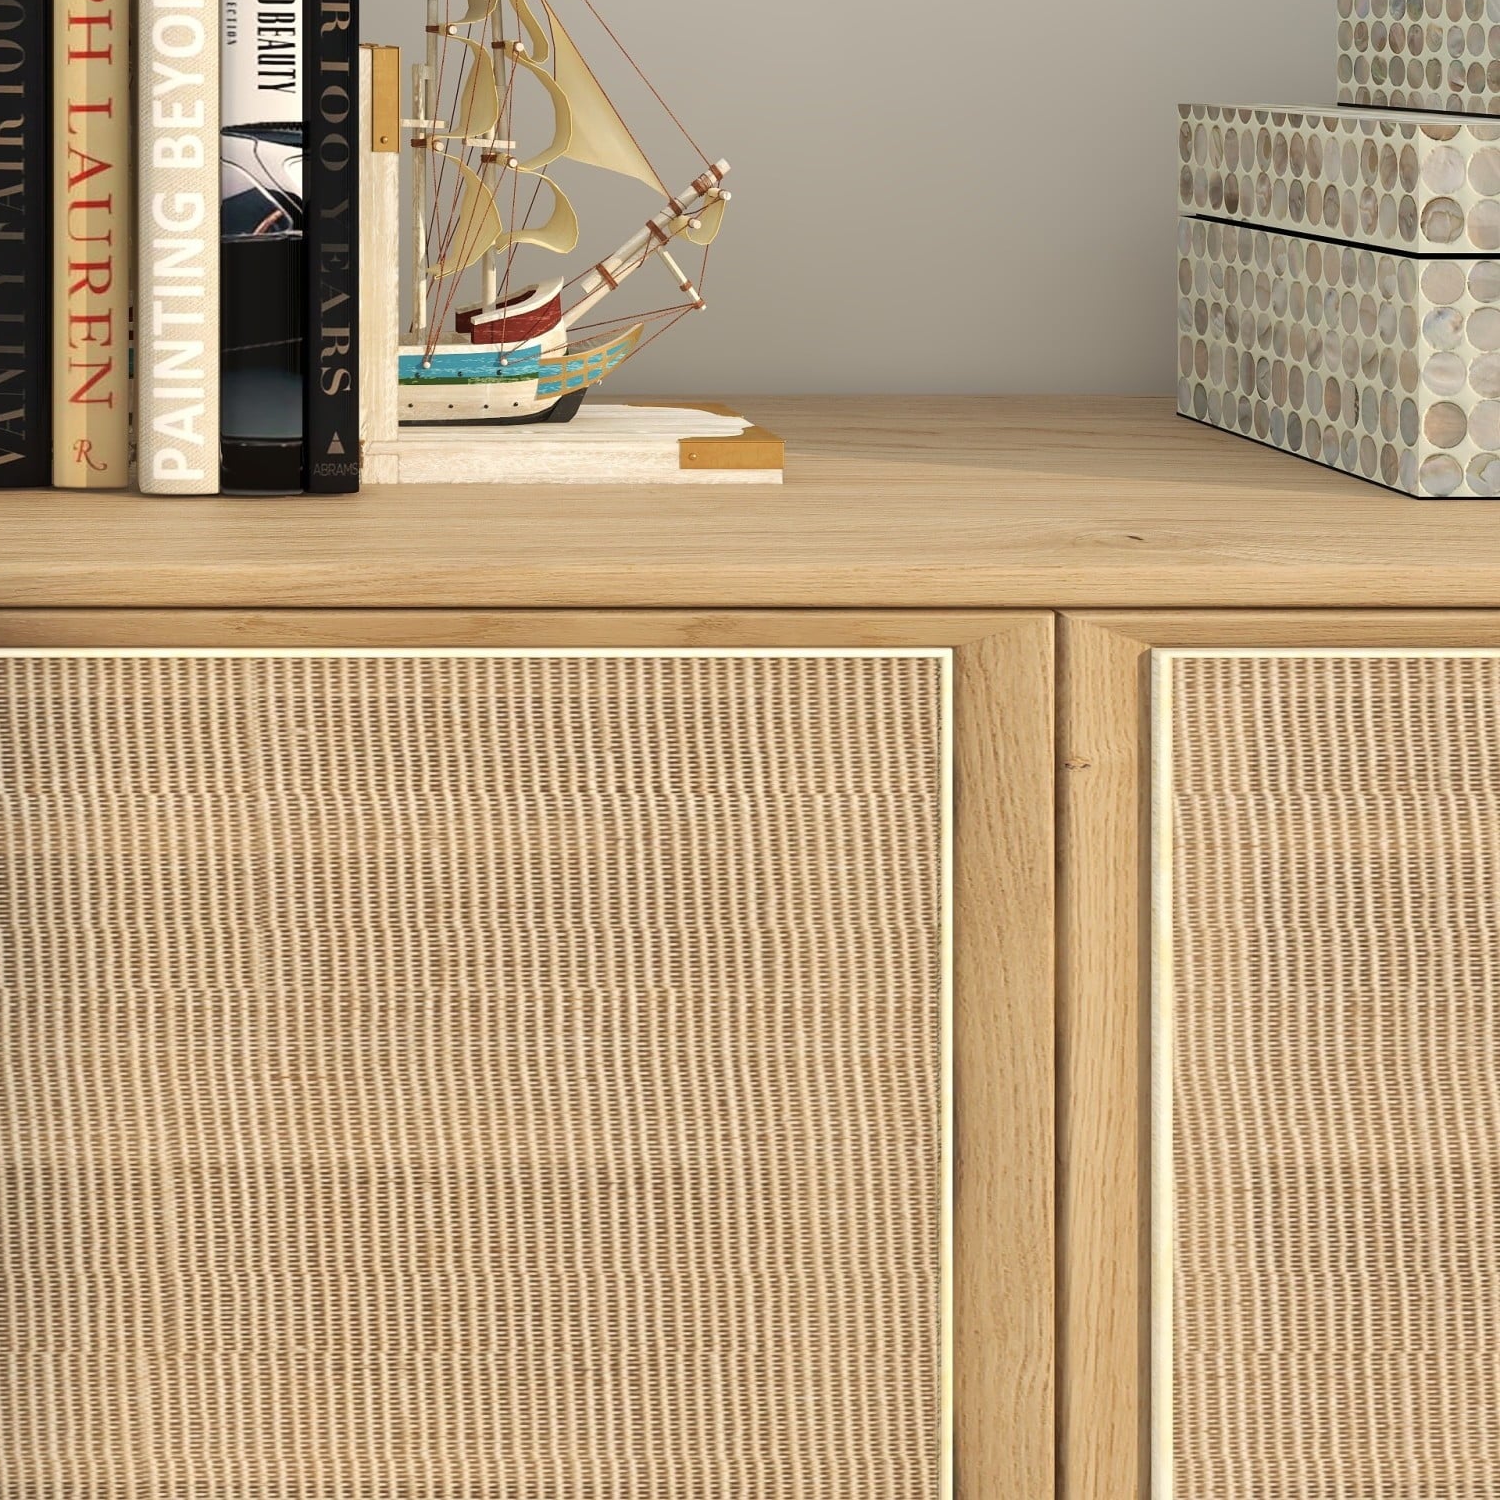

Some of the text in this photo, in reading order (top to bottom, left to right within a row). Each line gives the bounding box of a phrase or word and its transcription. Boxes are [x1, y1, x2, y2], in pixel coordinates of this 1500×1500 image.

[256, 12, 297, 94] BEAUTY
[66, 97, 114, 410] LAUREN
[152, 190, 206, 481] PAINTING
[319, 199, 352, 397] YEARS
[312, 461, 359, 477] ABRAMS
